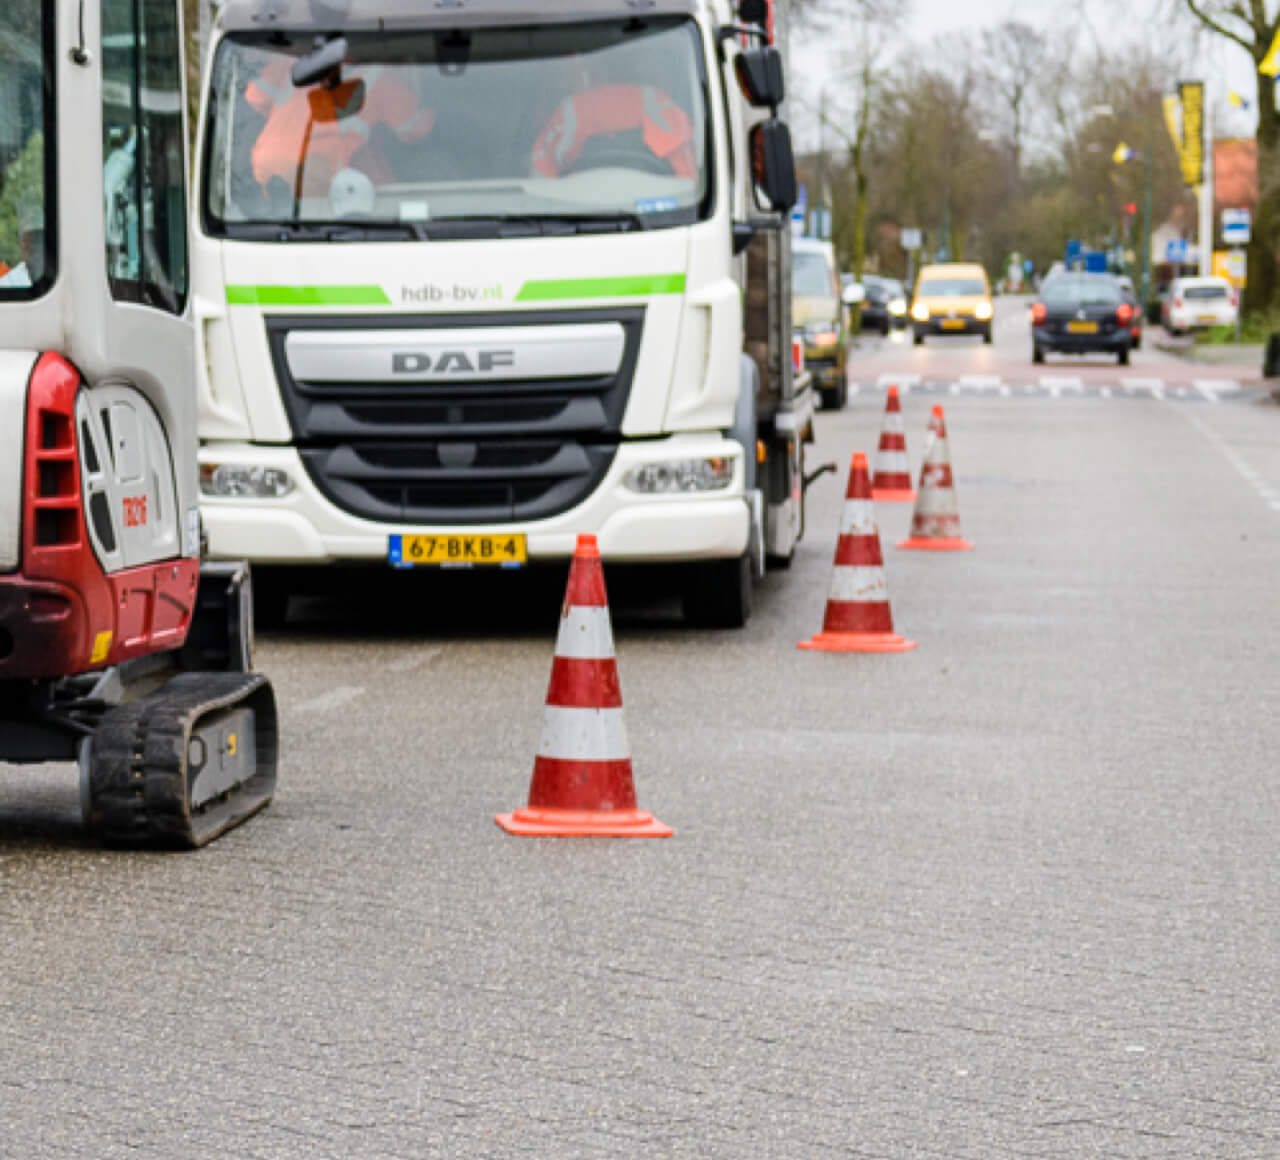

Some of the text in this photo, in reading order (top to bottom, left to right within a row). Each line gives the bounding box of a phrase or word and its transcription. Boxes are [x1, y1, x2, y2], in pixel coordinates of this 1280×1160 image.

[401, 280, 504, 302] hdb-bv.nl
[392, 349, 515, 373] DAF
[409, 537, 517, 558] 67-BKB-4
